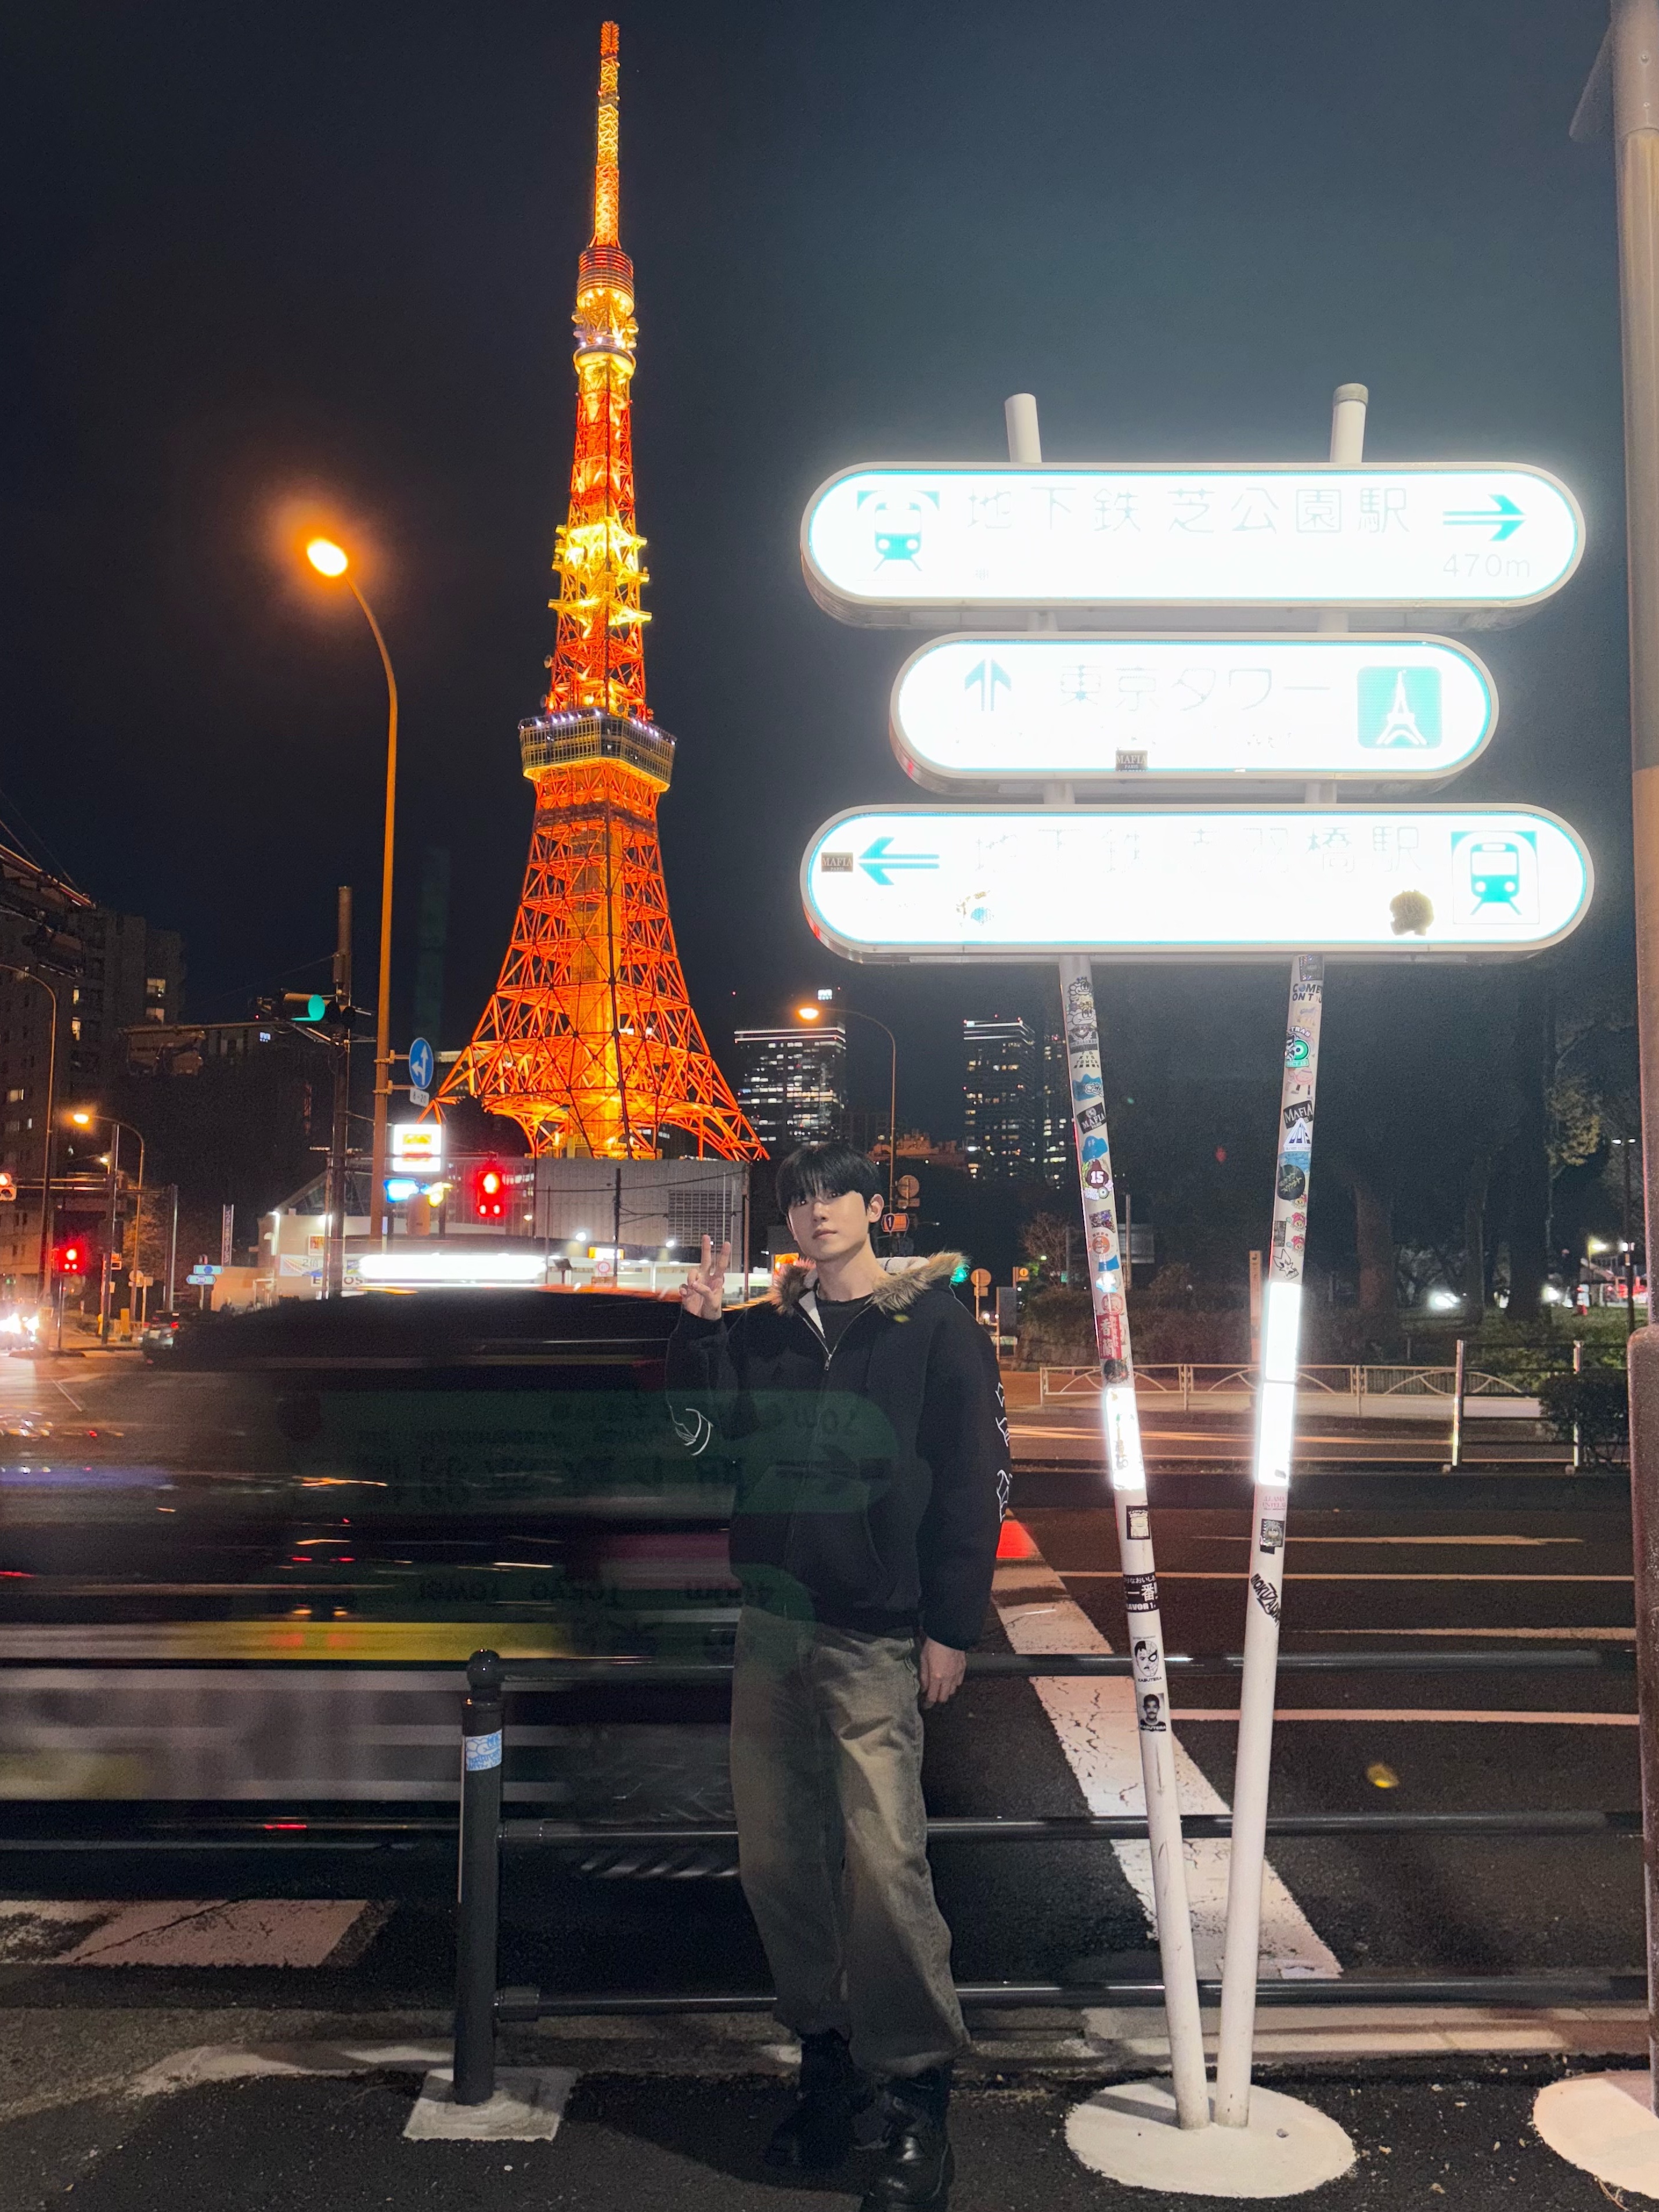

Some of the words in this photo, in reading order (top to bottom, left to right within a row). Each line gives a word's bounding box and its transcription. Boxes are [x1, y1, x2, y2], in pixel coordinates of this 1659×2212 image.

[1443, 553, 1531, 579] 470m
[1059, 664, 1330, 712] 東京タワー
[1116, 754, 1147, 764] MAFIA
[822, 858, 852, 866] MAFIA
[1292, 993, 1305, 1001] ON
[1081, 1112, 1105, 1129] MAFIA
[1284, 1103, 1313, 1124] MAFIA
[1091, 1170, 1104, 1184] 15
[888, 1216, 892, 1227] 1
[1124, 1581, 1159, 1602] 一番!
